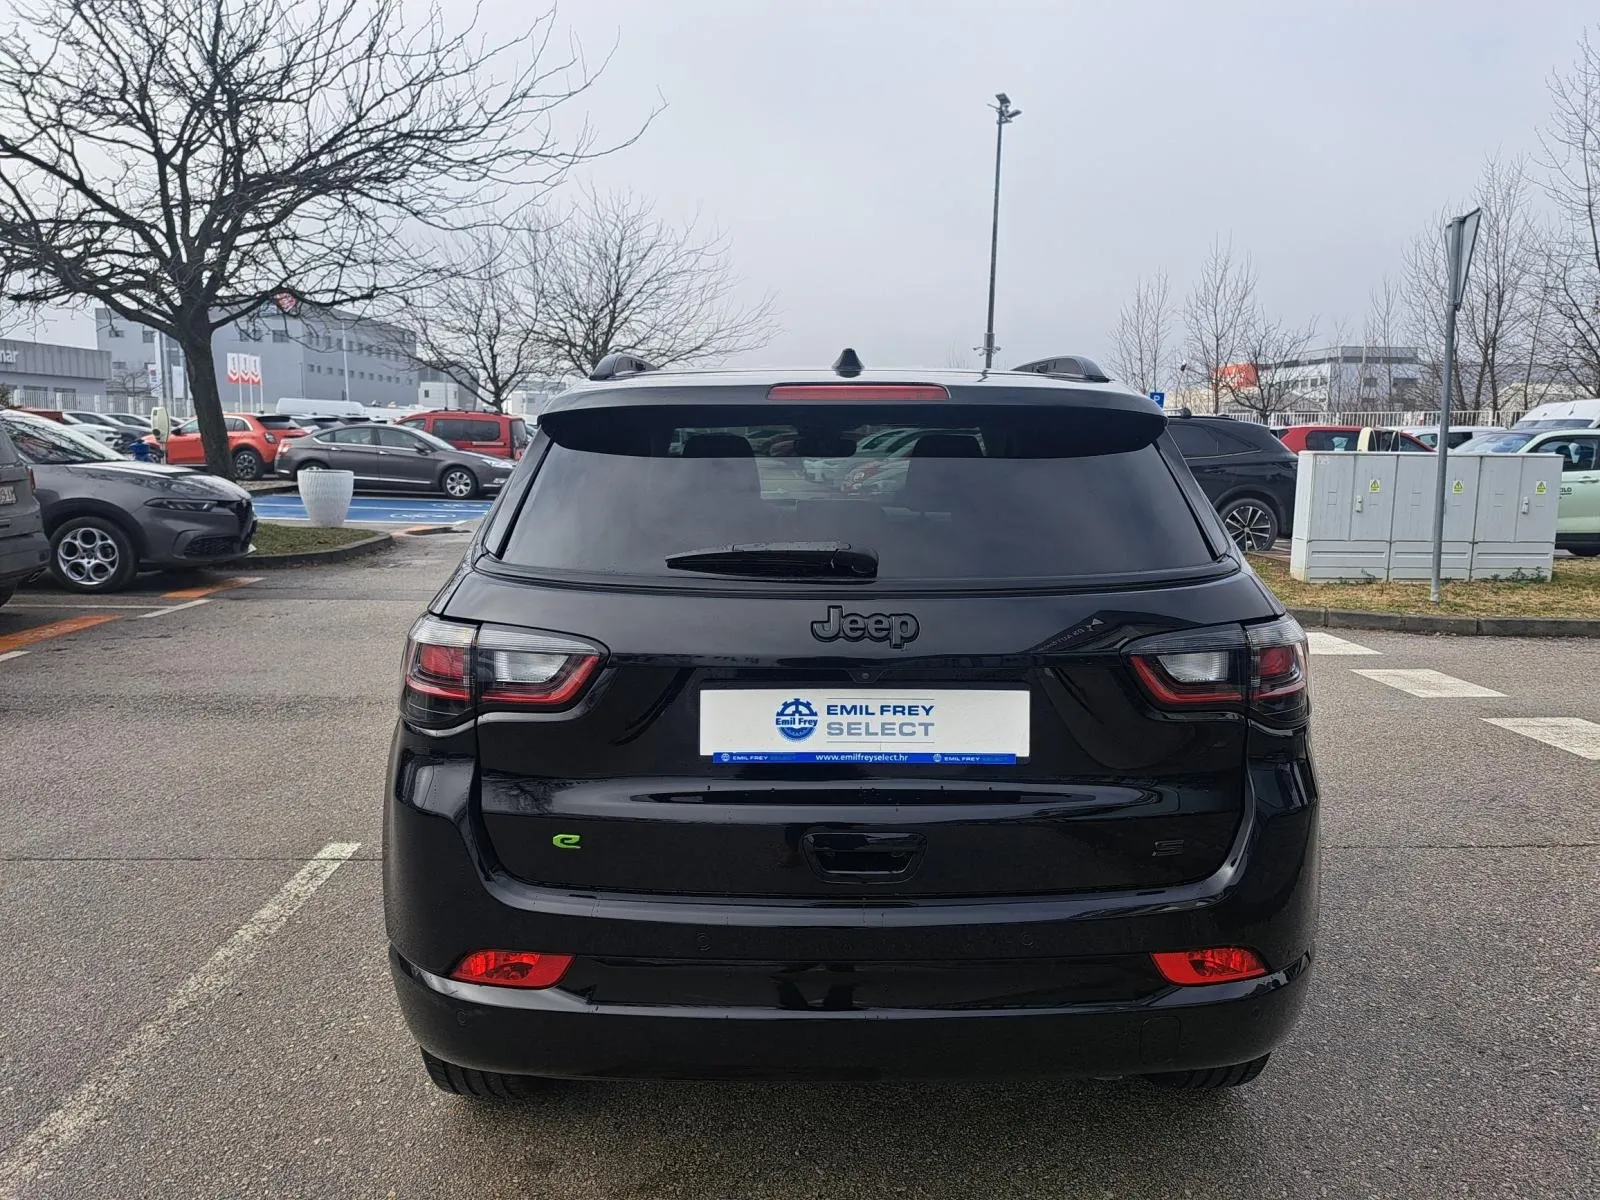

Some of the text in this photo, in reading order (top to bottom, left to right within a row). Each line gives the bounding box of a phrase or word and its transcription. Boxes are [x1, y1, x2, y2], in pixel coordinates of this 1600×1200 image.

[811, 605, 920, 649] Jeep
[826, 704, 935, 717] EMIL FREY
[775, 717, 819, 728] Emil Frey
[826, 721, 935, 737] SELECT
[815, 753, 909, 763] www.emilfreyselect.hr
